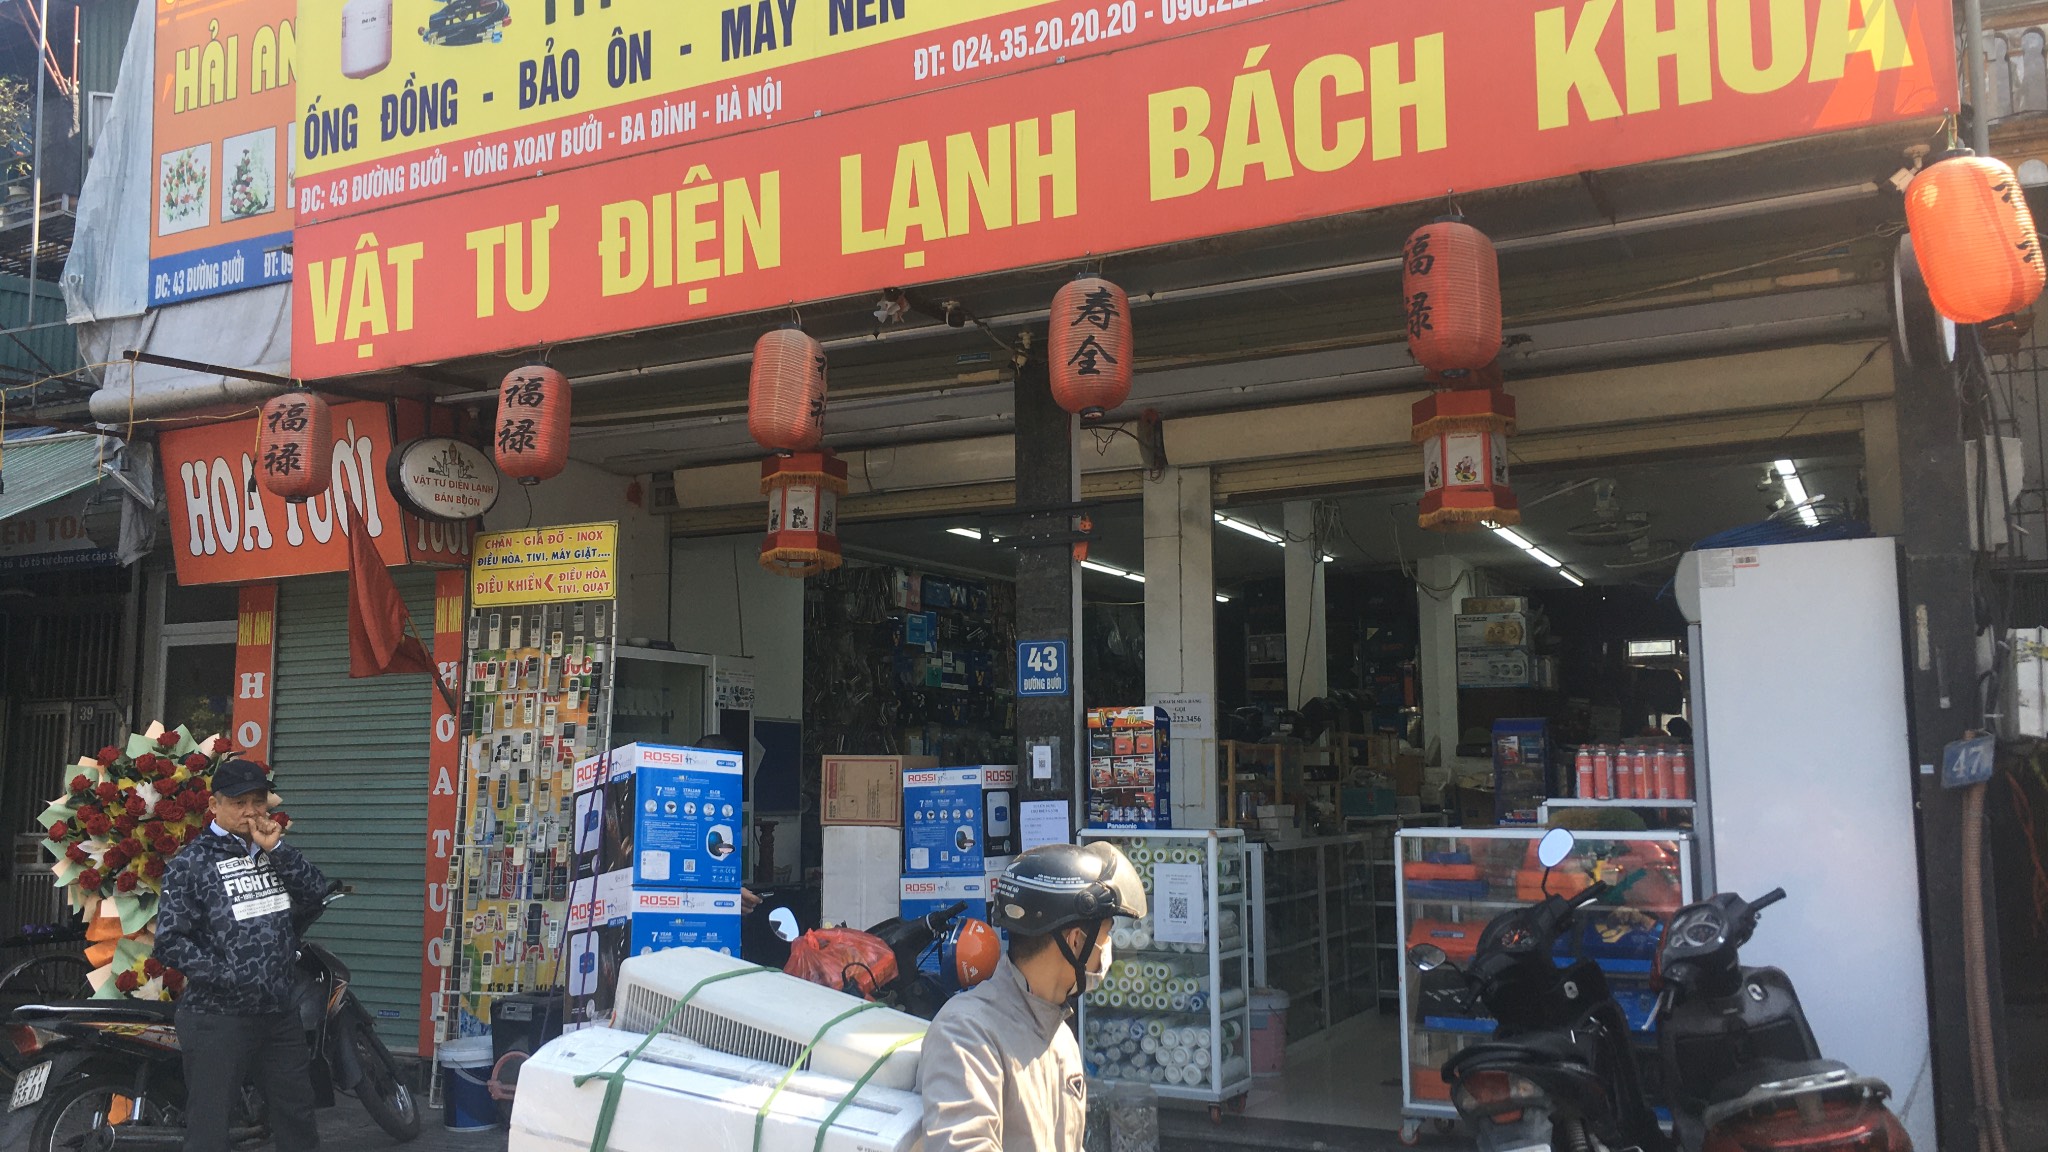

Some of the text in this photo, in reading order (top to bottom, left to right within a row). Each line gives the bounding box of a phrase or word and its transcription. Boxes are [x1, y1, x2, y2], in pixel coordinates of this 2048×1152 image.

[174, 18, 239, 115] HẢI
[303, 95, 358, 161] ỐNG
[380, 71, 459, 142] ĐỒNG
[518, 37, 580, 110] BẢO
[606, 26, 652, 89] ÔN
[301, 185, 325, 214] ĐC:
[330, 179, 348, 207] 43
[352, 164, 405, 203] ĐƯỜNG
[409, 148, 448, 190] BƯỞI
[463, 141, 508, 178] VÒNG
[513, 132, 556, 168] XOAY
[560, 113, 602, 158] BƯỞI
[620, 112, 646, 145] BA
[651, 100, 696, 138] ĐÌNH
[715, 85, 742, 124] HÀ
[748, 76, 782, 120] NỘI
[913, 45, 946, 82] ĐT:
[951, 4, 1137, 73] 024.35.20.20.20
[308, 231, 424, 359] VẬT
[466, 204, 560, 319] TƯ
[597, 163, 782, 306] ĐIỆN
[840, 109, 1079, 269] LẠNH
[1147, 32, 1448, 202] BÁCH
[155, 273, 171, 299] ĐC:
[172, 269, 185, 296] 43
[187, 259, 219, 293] ĐƯỜNG
[221, 249, 245, 286] BƯỞI
[264, 251, 279, 278] ĐT:
[180, 452, 273, 556] HOA
[485, 536, 512, 550] CHÂN
[524, 531, 544, 546] GIÁ
[547, 530, 565, 544] ĐỠ
[577, 530, 603, 542] INOX
[477, 552, 499, 567] ĐIỀU
[501, 551, 523, 564] HÒA,
[526, 553, 549, 562] TIVI,
[551, 548, 571, 560] MÁY
[476, 571, 542, 594] ĐIỀU KHIỂN
[558, 567, 607, 582] ĐIỀU HÒA
[557, 581, 611, 594] TIVI, QUẠT
[475, 656, 507, 680] MY
[1027, 646, 1058, 672] 43
[1023, 673, 1062, 691] ĐƯỜNG BƯỞI
[643, 751, 683, 763] ROSSI
[1952, 745, 1983, 778] 47
[576, 759, 608, 783] ROSS
[907, 774, 936, 782] ROSSI
[985, 770, 1014, 782] ROSSI
[655, 786, 663, 796] 7
[1107, 821, 1138, 829] Panasonic
[905, 883, 936, 892] ROSSI
[571, 899, 605, 921] ROSSI
[639, 895, 680, 906] ROSSI
[651, 932, 659, 943] 7
